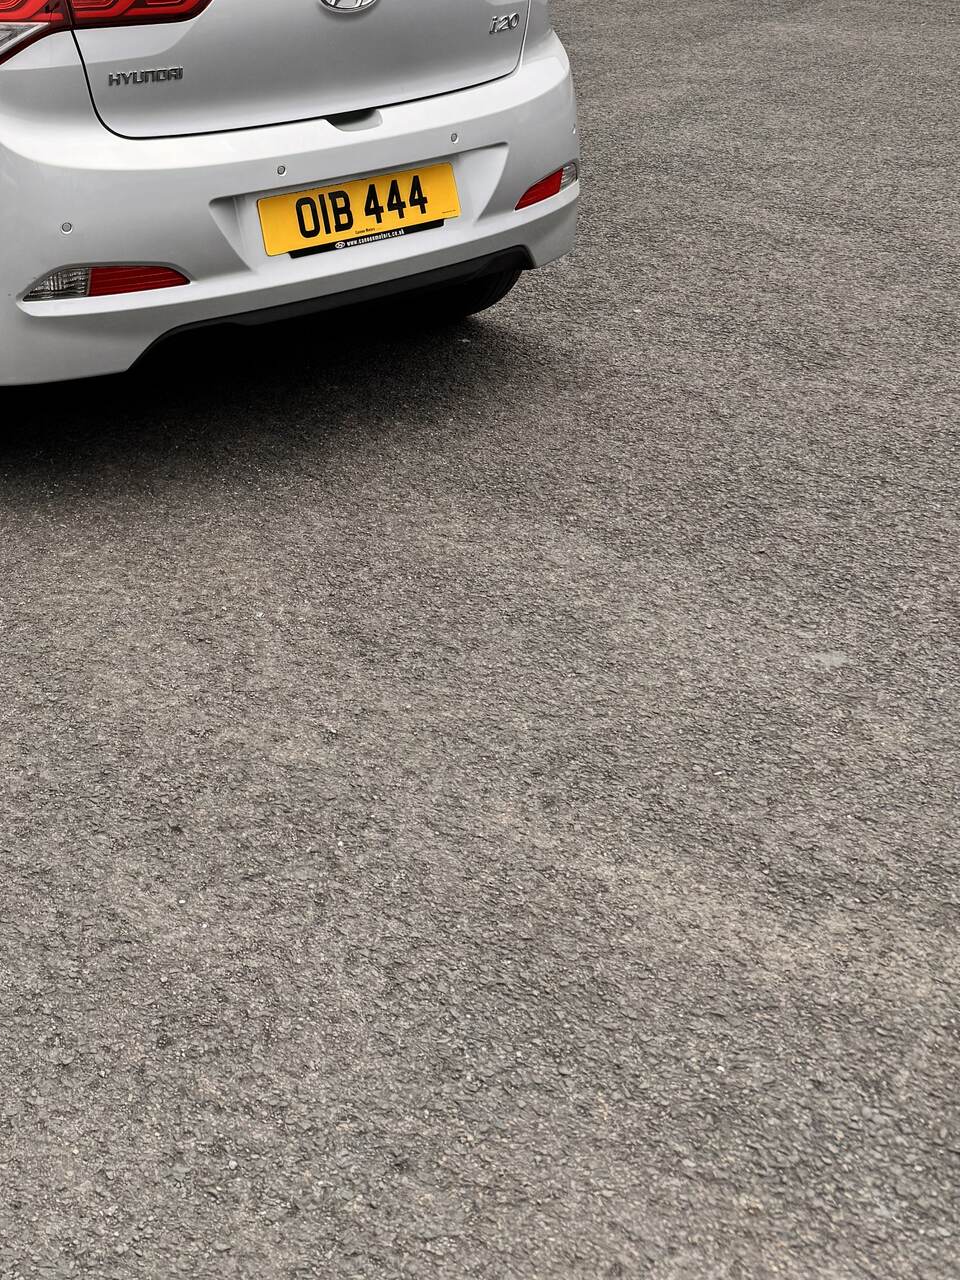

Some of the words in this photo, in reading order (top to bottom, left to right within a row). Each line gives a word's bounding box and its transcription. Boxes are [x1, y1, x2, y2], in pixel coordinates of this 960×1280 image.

[489, 13, 519, 34] i20
[108, 66, 183, 86] HYUNDAI
[295, 190, 354, 239] OIB
[364, 175, 428, 224] 444
